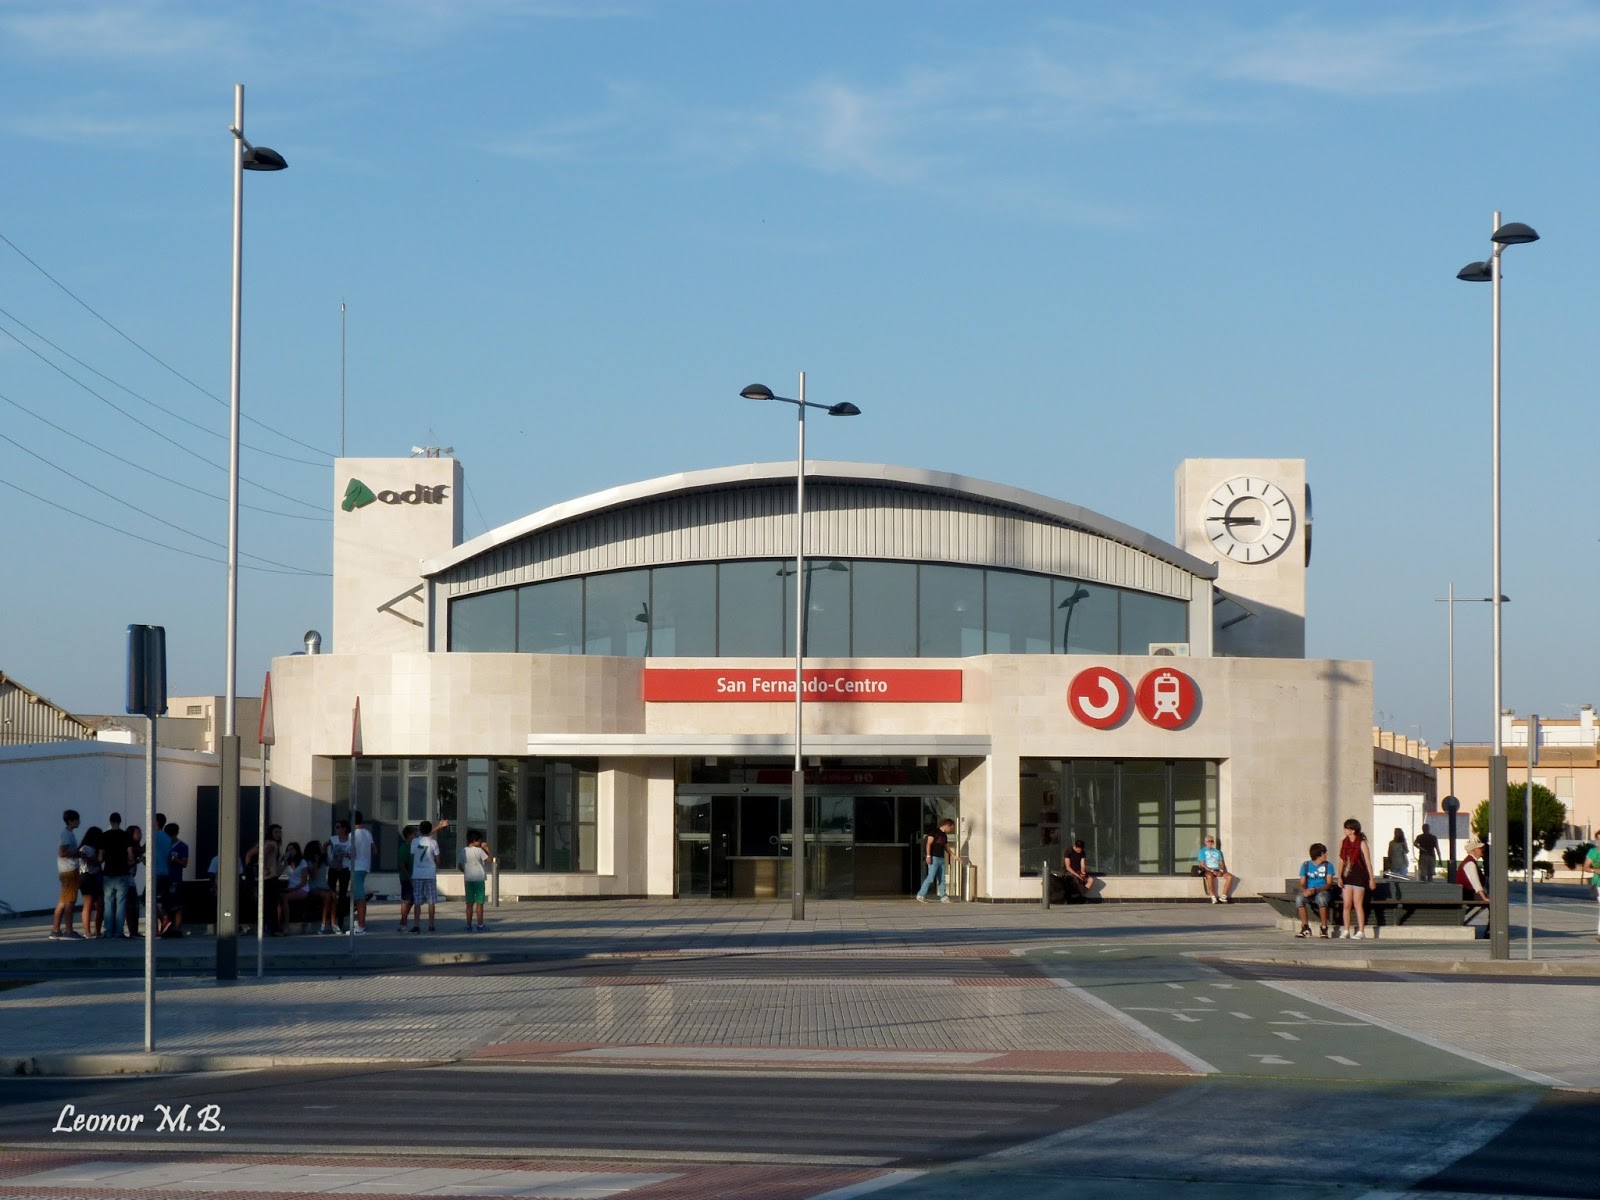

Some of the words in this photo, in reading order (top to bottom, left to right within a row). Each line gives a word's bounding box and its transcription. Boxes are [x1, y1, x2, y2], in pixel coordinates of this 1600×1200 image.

[377, 483, 451, 505] adif
[717, 677, 746, 693] San
[752, 676, 888, 693] Fernando-Centro
[417, 844, 429, 863] 7
